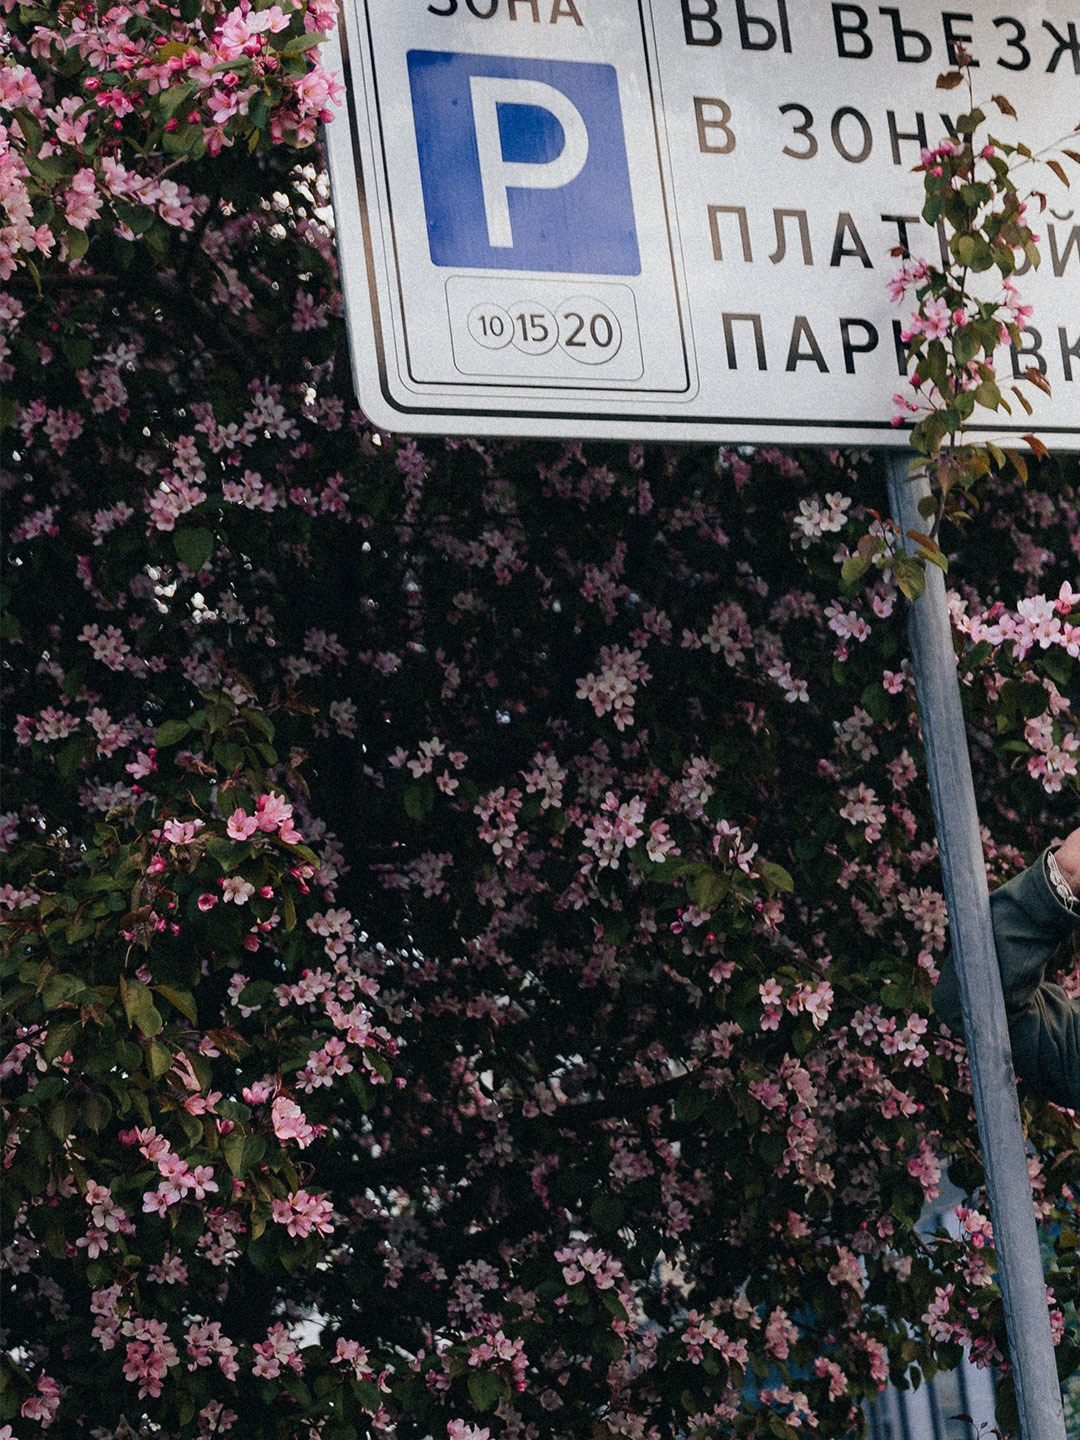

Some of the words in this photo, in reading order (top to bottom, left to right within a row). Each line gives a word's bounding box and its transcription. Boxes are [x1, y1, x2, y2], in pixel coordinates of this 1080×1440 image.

[678, 0, 793, 53] ВЫ
[694, 96, 737, 154] В
[468, 76, 589, 248] P
[478, 314, 504, 337] 10
[516, 313, 549, 342] 15
[563, 312, 614, 348] 20
